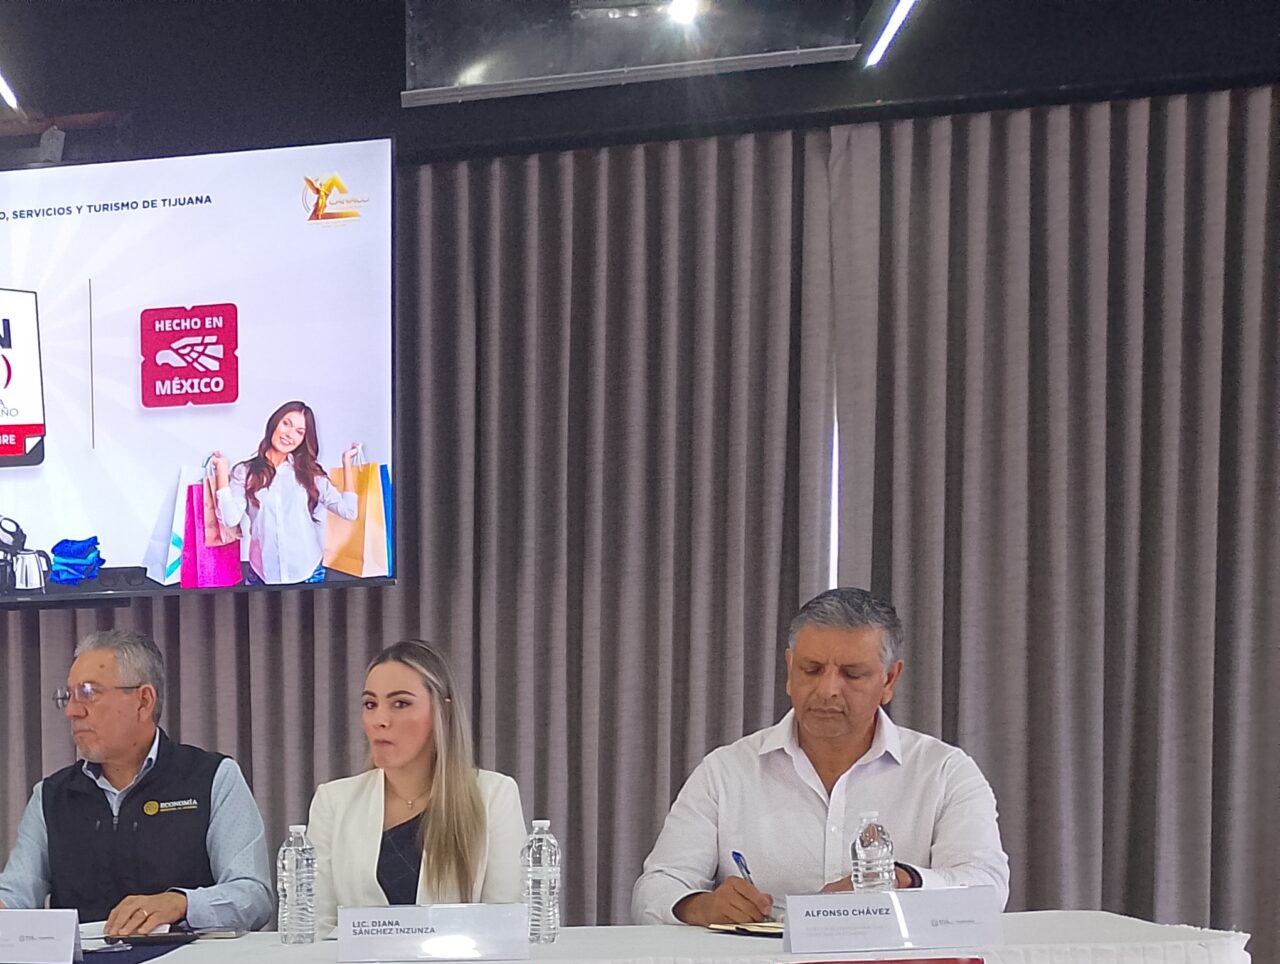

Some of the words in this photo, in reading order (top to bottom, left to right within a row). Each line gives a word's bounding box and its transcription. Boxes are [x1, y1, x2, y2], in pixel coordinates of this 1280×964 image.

[12, 206, 72, 220] SERVICIOS
[76, 205, 84, 214] Y
[87, 201, 139, 214] TURISMO
[142, 199, 158, 209] DE
[161, 195, 212, 208] TIJUANA
[155, 318, 201, 332] HECHO
[205, 316, 223, 329] EN
[155, 376, 224, 395] MÉXICO
[804, 909, 850, 918] ALFONSO
[851, 907, 891, 917] CHÁVEZ
[395, 927, 436, 935] INZUNZA
